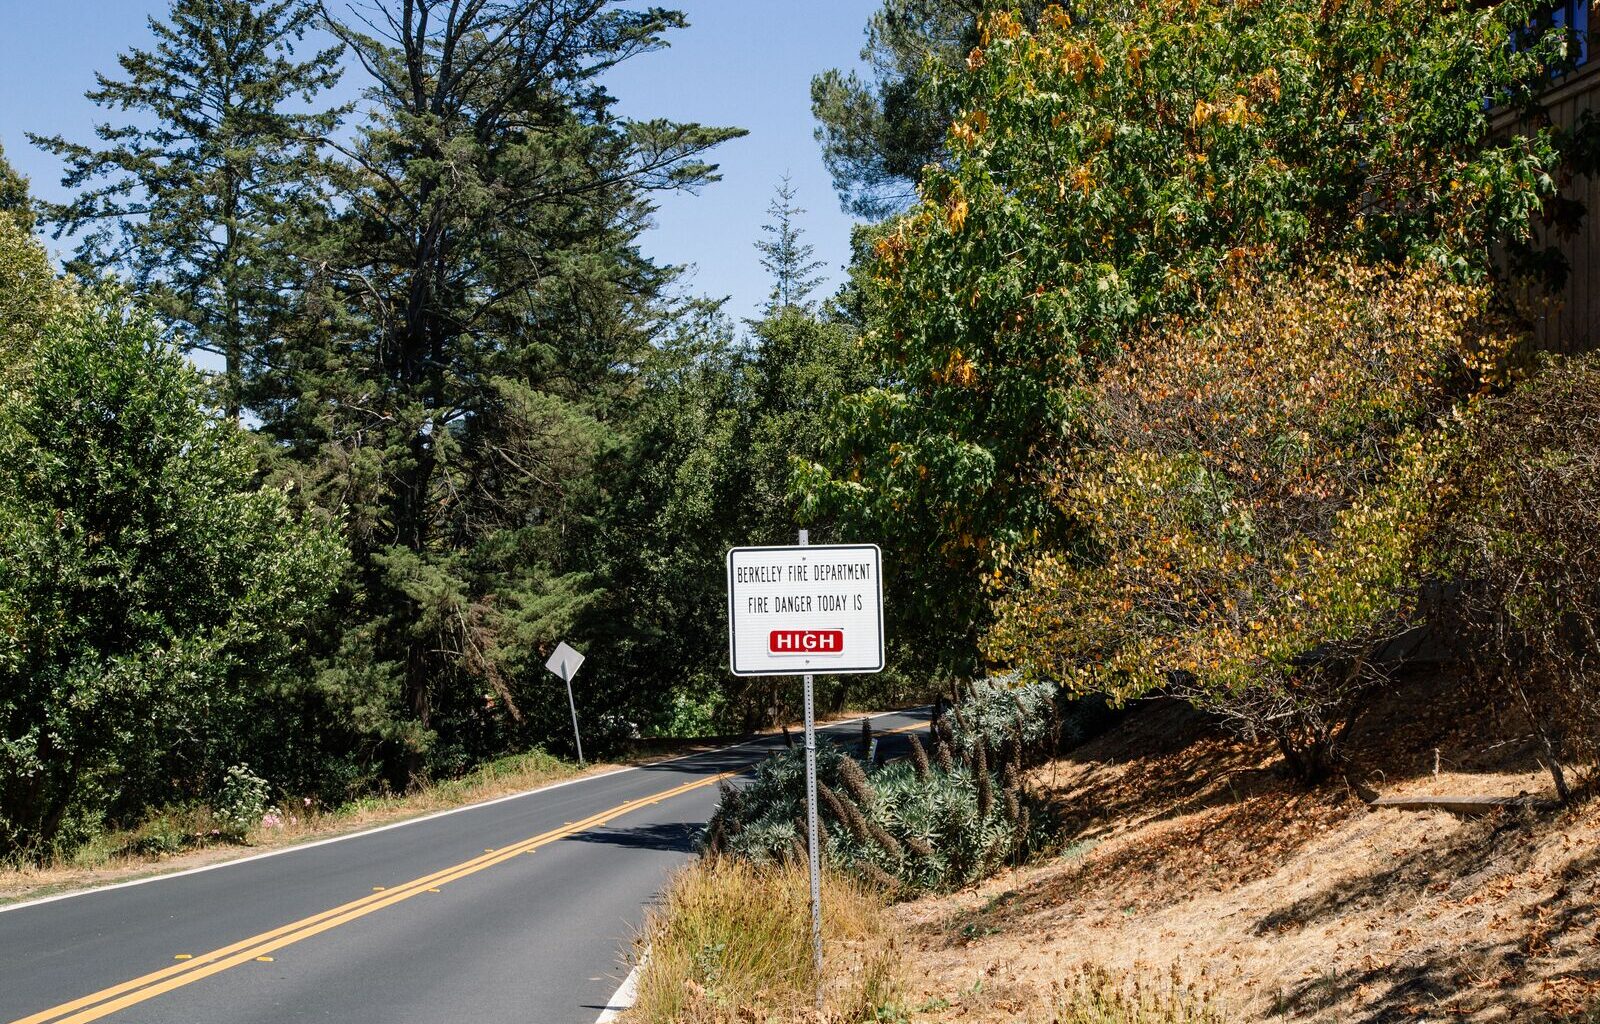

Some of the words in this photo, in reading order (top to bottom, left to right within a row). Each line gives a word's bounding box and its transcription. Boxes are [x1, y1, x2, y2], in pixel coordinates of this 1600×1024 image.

[737, 566, 782, 583] BERKELEY
[788, 565, 808, 582] FIRE
[814, 563, 870, 581] DEPARTMENT
[748, 596, 769, 613] FIRE
[775, 595, 812, 612] DANGER
[818, 595, 847, 611] TODAY
[853, 594, 863, 611] IS
[777, 634, 834, 649] HIGH
